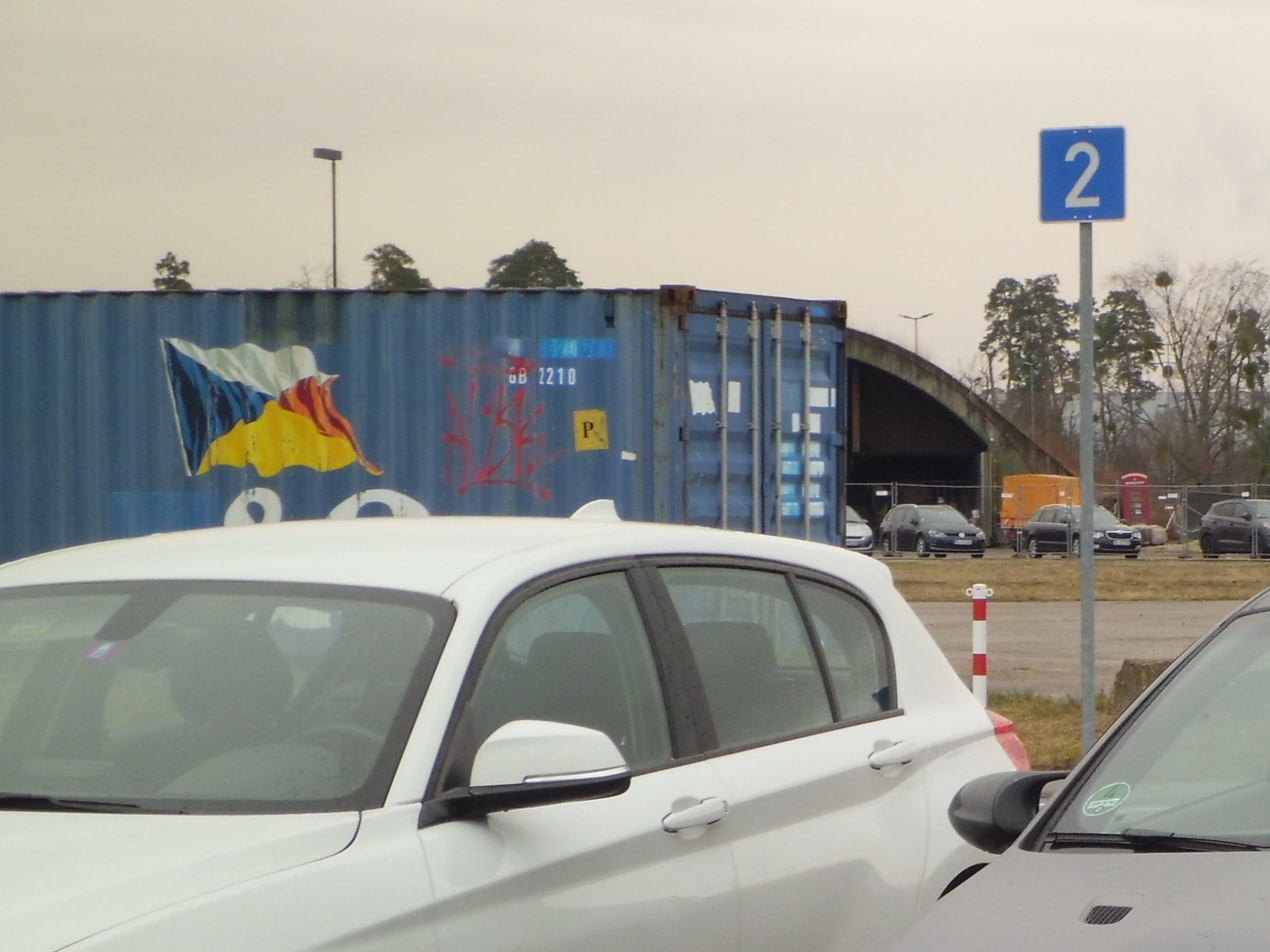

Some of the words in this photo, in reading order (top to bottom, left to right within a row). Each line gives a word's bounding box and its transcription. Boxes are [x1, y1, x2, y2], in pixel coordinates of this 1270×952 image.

[1064, 141, 1100, 208] 2
[538, 368, 577, 385] 2210
[582, 421, 594, 439] P
